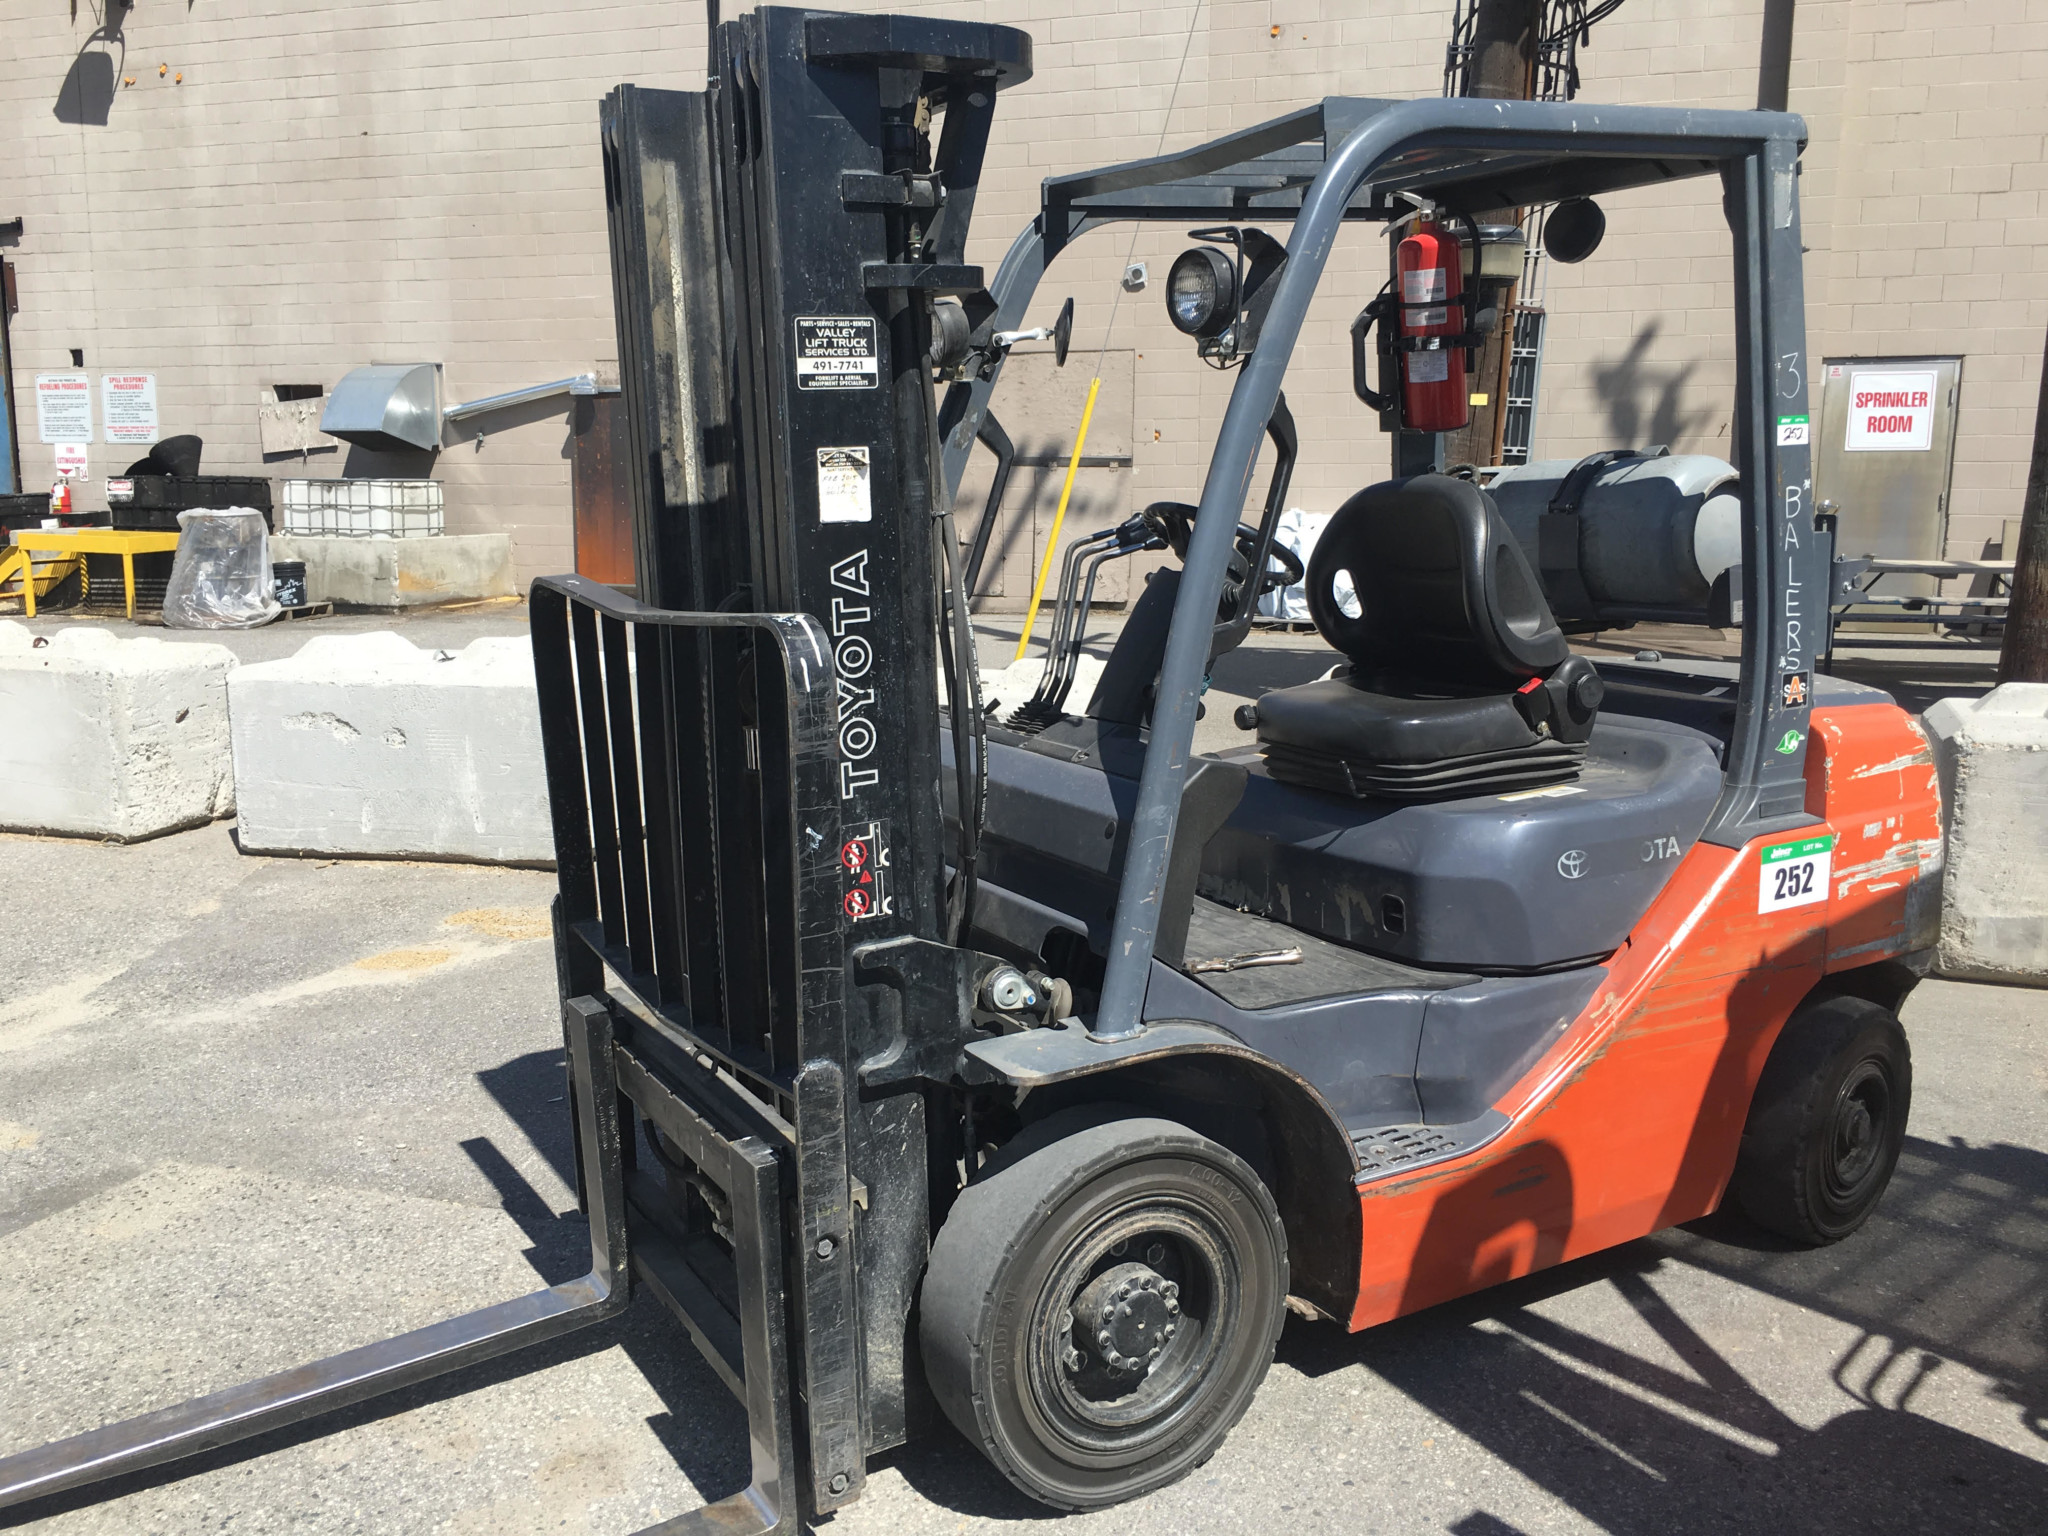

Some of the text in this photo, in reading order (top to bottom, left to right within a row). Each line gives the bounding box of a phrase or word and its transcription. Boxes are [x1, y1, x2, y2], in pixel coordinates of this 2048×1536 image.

[816, 328, 856, 337] VALLEY
[805, 338, 868, 347] LIFT TRUCK
[805, 348, 870, 356] SERVICES LTD.
[813, 360, 864, 370] 491-7741
[1855, 391, 1928, 408] SPRINKLER
[1867, 415, 1913, 433] ROOM
[830, 549, 879, 800] TOYOTA
[1774, 862, 1814, 901] 252
